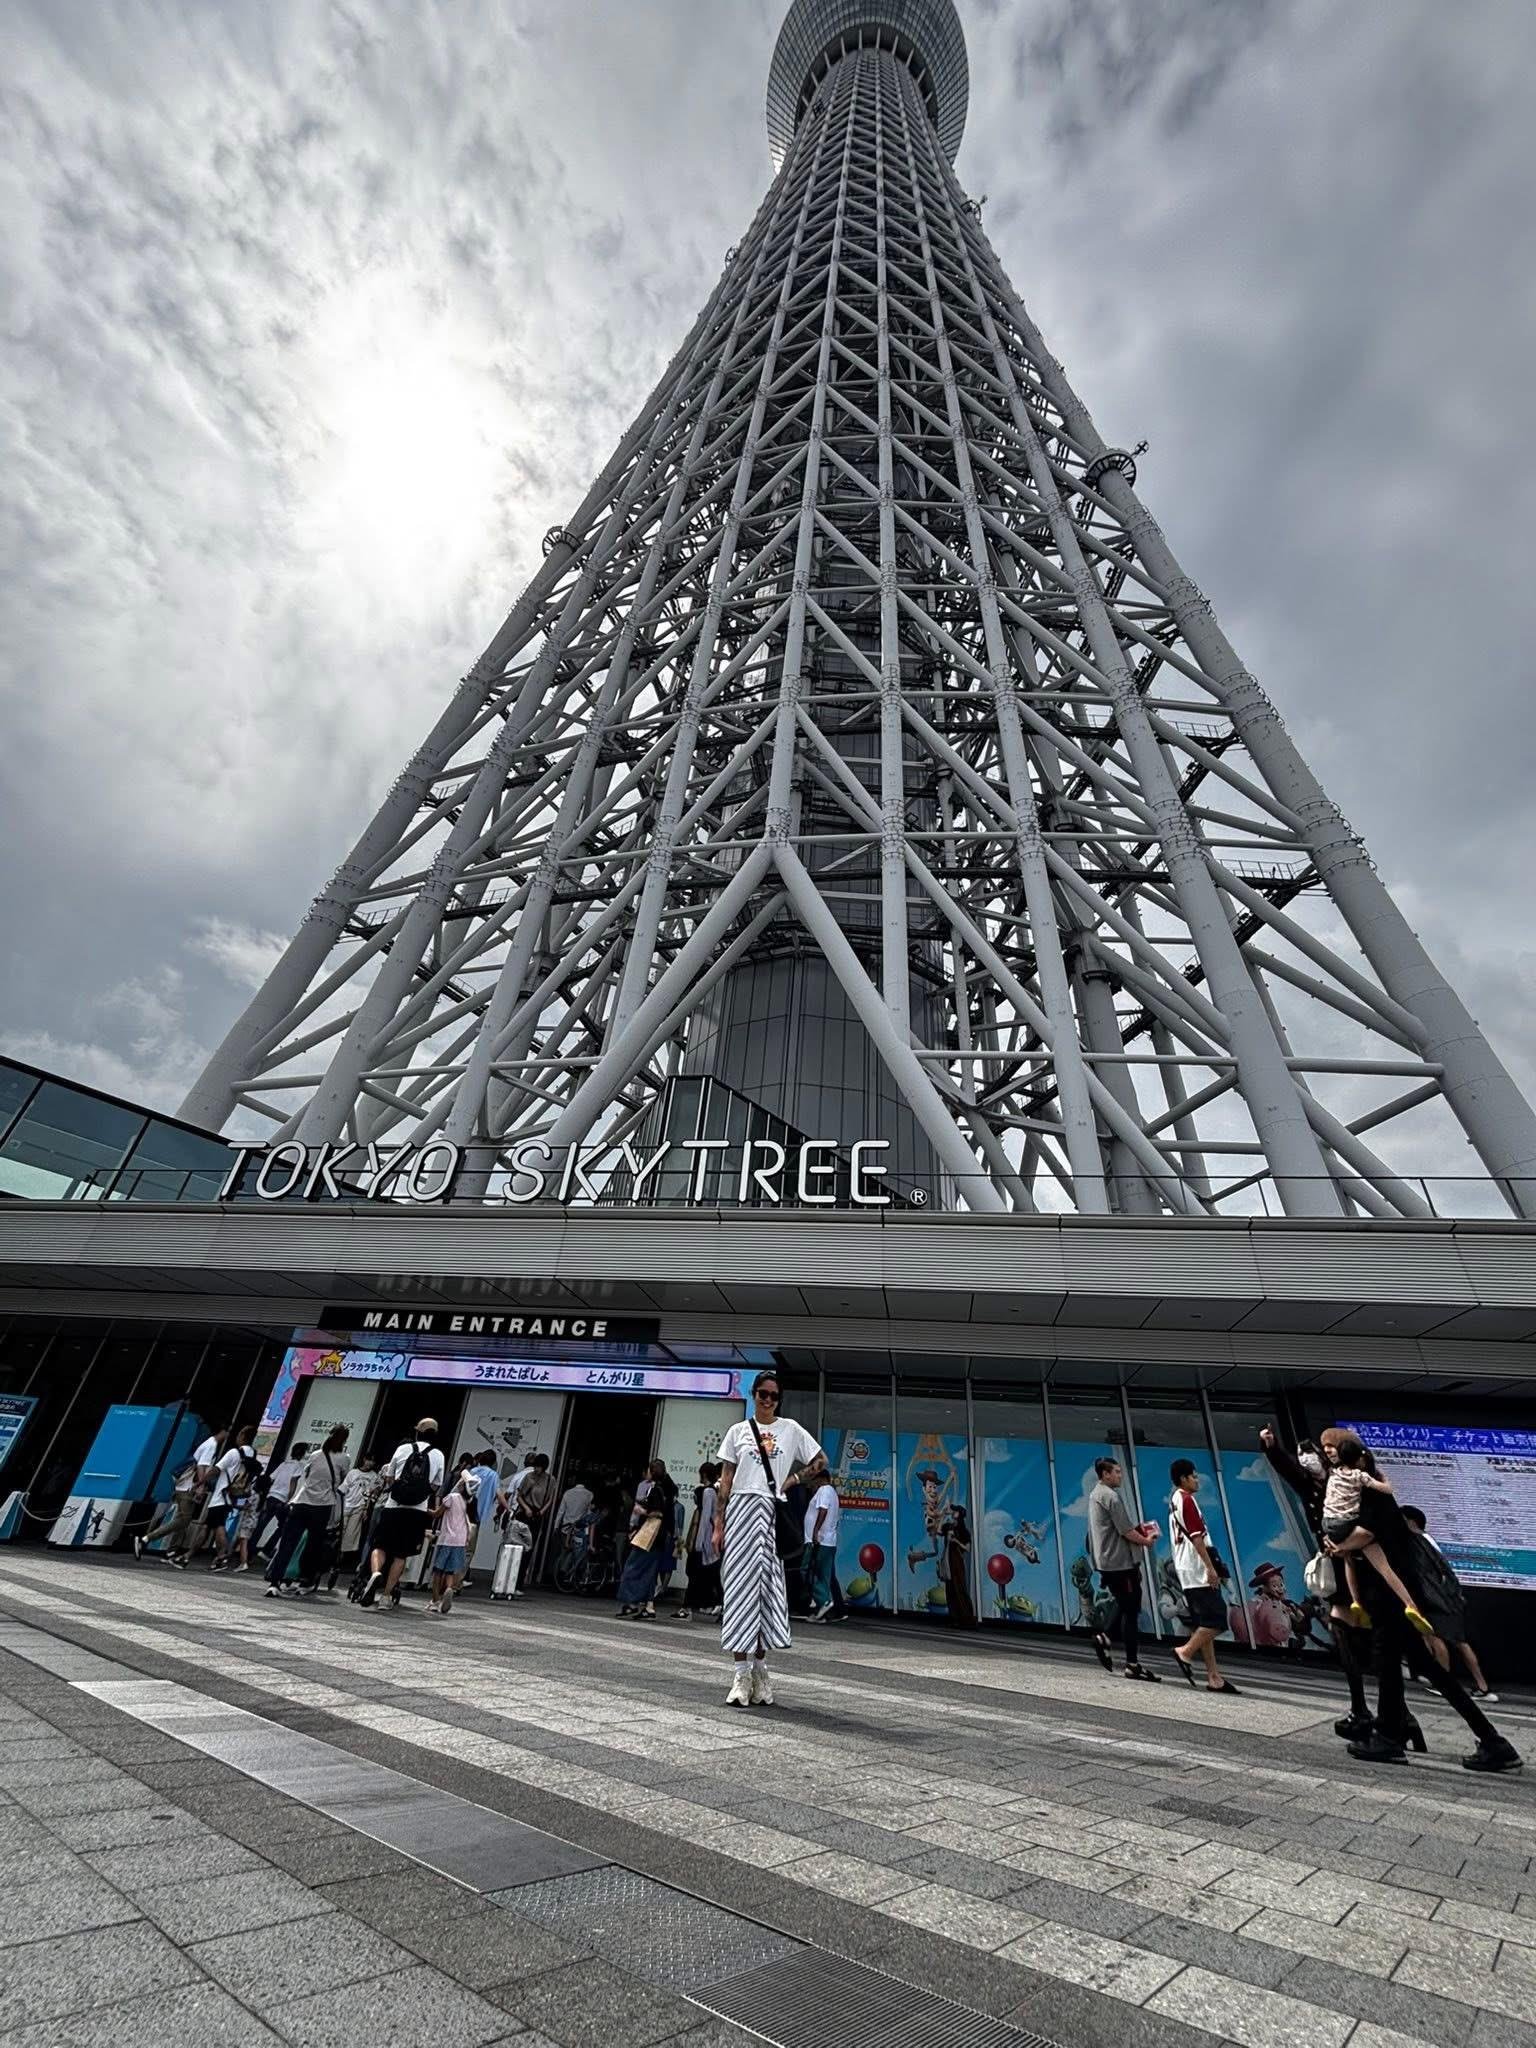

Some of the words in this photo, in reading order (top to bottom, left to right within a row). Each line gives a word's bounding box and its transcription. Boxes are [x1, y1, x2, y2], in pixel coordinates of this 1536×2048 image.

[220, 1140, 464, 1203] TOKYO
[502, 1140, 892, 1204] SKYTREE
[363, 1312, 434, 1331] MAIN
[450, 1315, 609, 1338] ENTRANCE
[342, 1362, 392, 1374] ソラカラちゃん
[473, 1364, 551, 1382] うまれたばしょ
[586, 1370, 646, 1387] とんがり星
